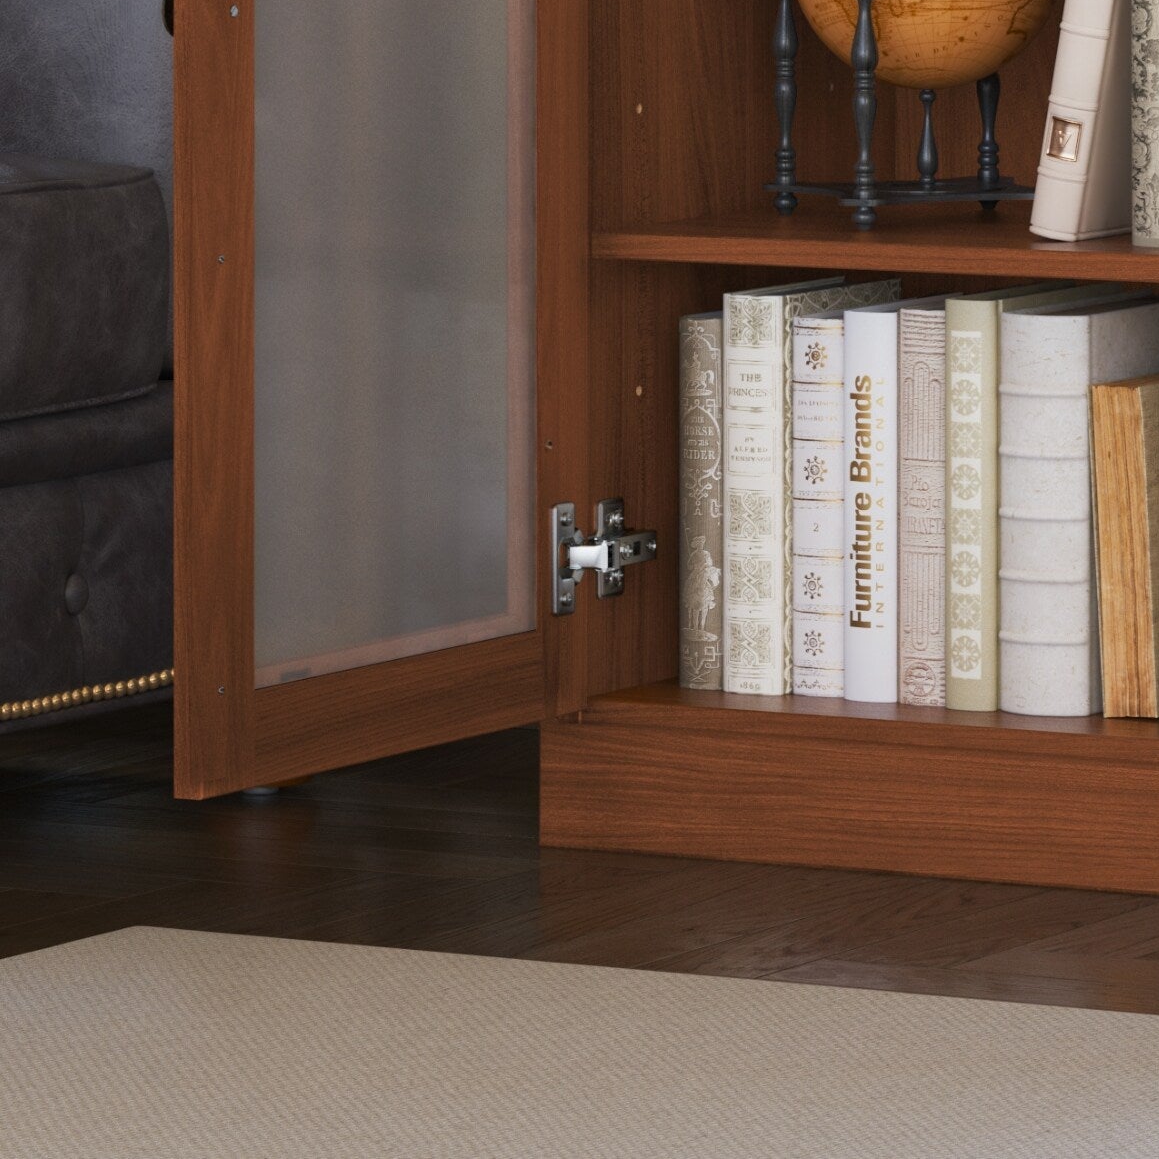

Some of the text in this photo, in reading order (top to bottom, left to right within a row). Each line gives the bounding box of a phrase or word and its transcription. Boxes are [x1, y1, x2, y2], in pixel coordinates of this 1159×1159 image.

[740, 373, 762, 382] THE
[813, 522, 819, 532] 2
[850, 375, 872, 629] Furniture Brands
[876, 377, 885, 629] INTERNATIONAL
